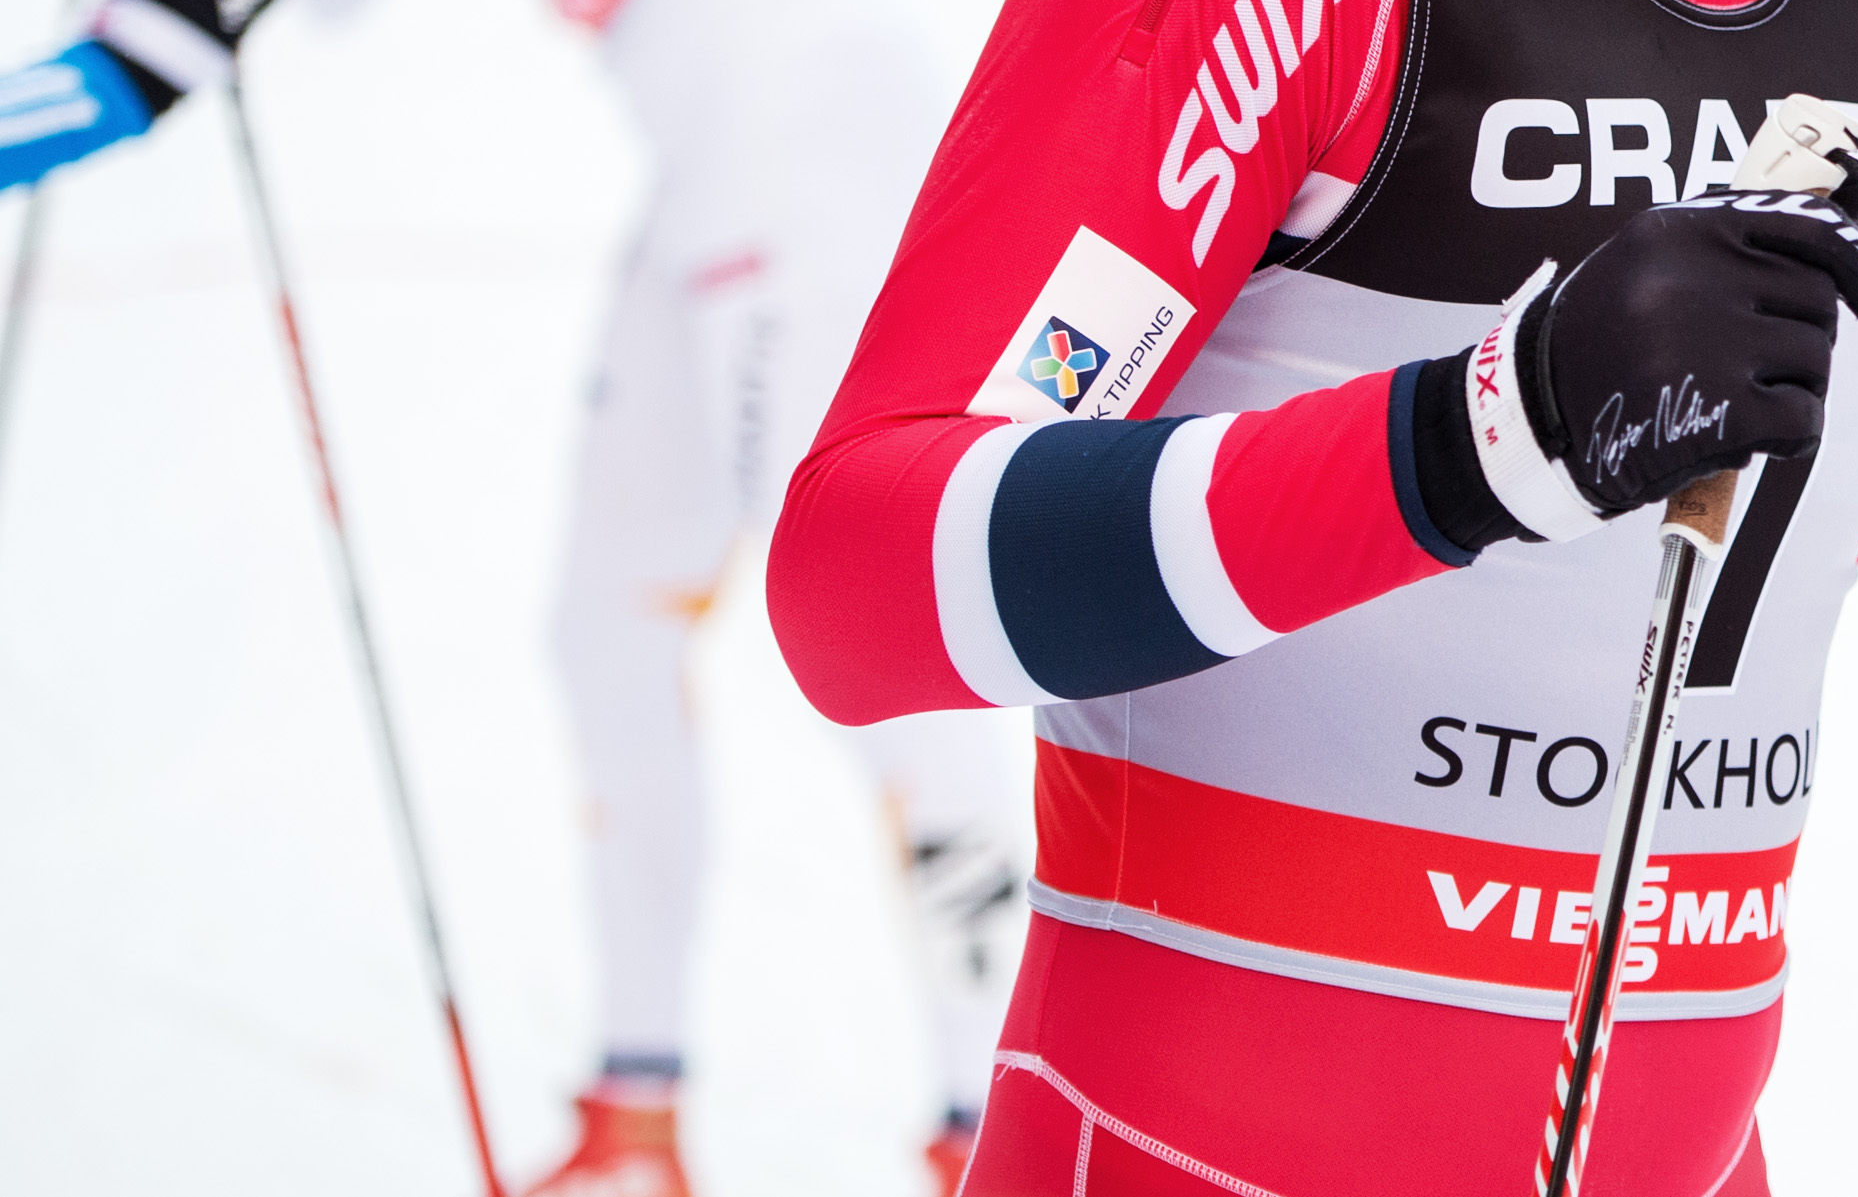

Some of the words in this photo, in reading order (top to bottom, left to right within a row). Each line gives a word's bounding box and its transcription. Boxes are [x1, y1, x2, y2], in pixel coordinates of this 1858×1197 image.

[1103, 306, 1174, 401] TIPPING
[1671, 620, 1694, 700] PETTER
[1414, 715, 1819, 810] STOKHOL
